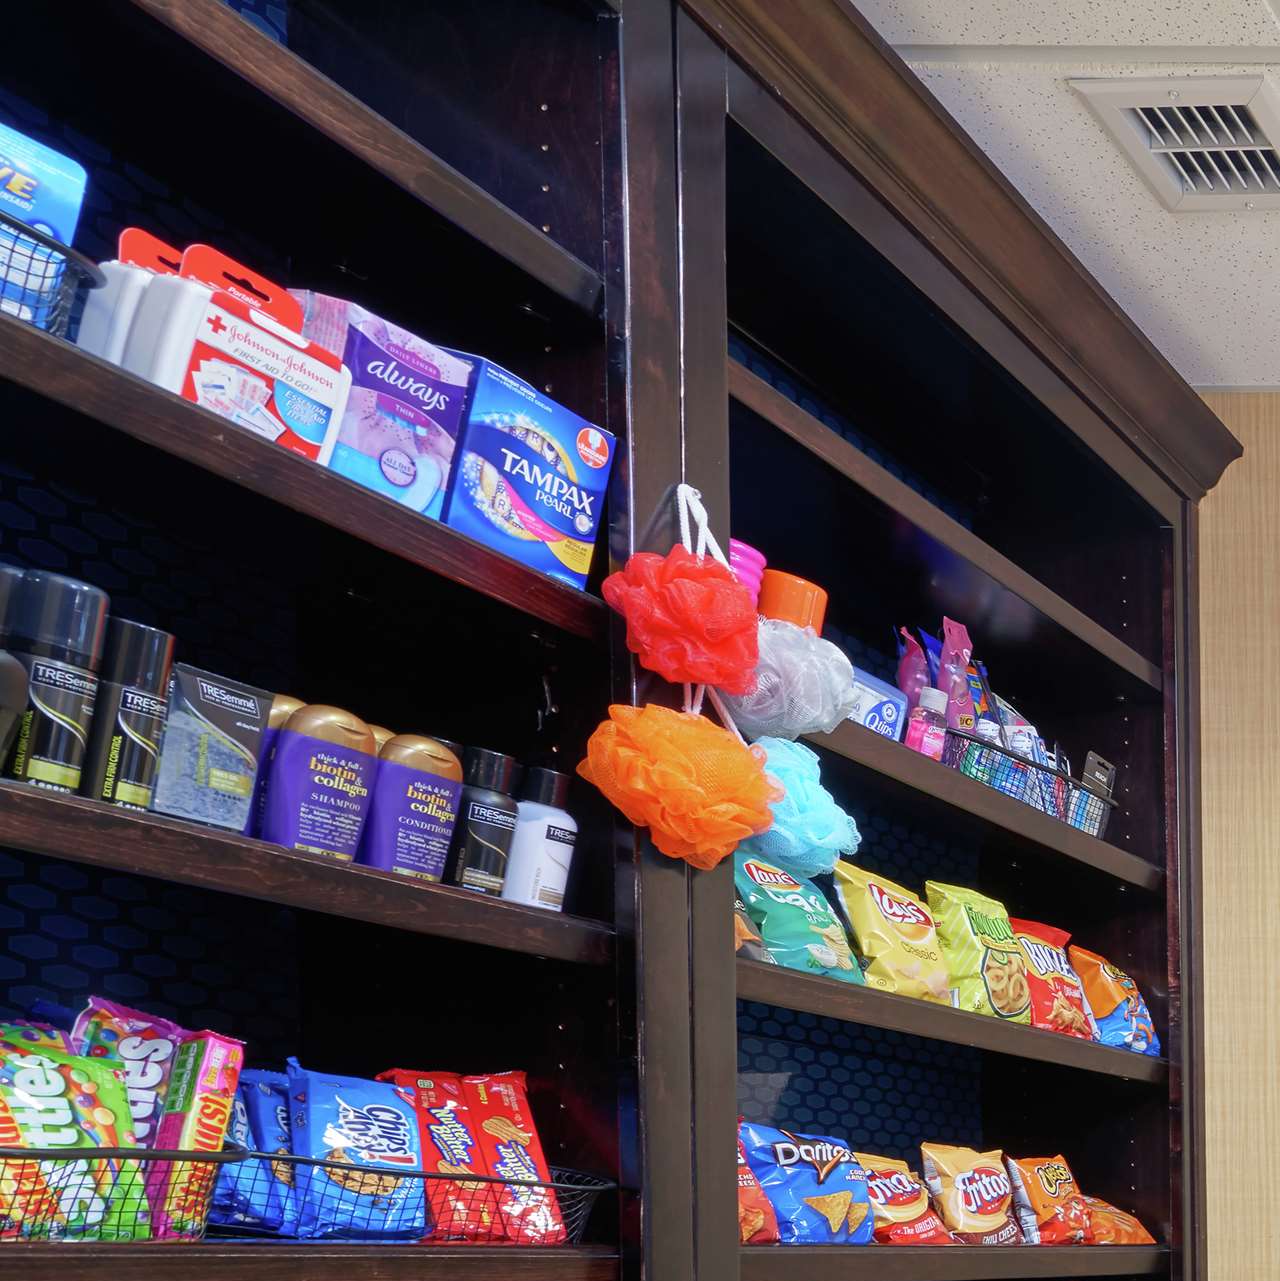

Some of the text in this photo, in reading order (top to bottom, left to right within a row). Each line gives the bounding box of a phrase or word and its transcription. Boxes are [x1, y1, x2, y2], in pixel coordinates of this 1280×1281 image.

[227, 286, 262, 308] Portable
[233, 347, 261, 364] FIRST
[262, 362, 280, 375] AID
[281, 371, 294, 383] TO
[367, 360, 450, 411] always
[395, 404, 415, 420] THIN
[501, 447, 595, 515] TAMPAX
[309, 756, 357, 781] biotin
[313, 774, 368, 797] collagen
[406, 784, 447, 807] biotin
[310, 792, 361, 811] SHAMPOO
[410, 801, 455, 823] collagen
[430, 1107, 474, 1147] Nutter
[430, 1123, 471, 1164] Butter
[955, 1170, 1010, 1213] Fritos
